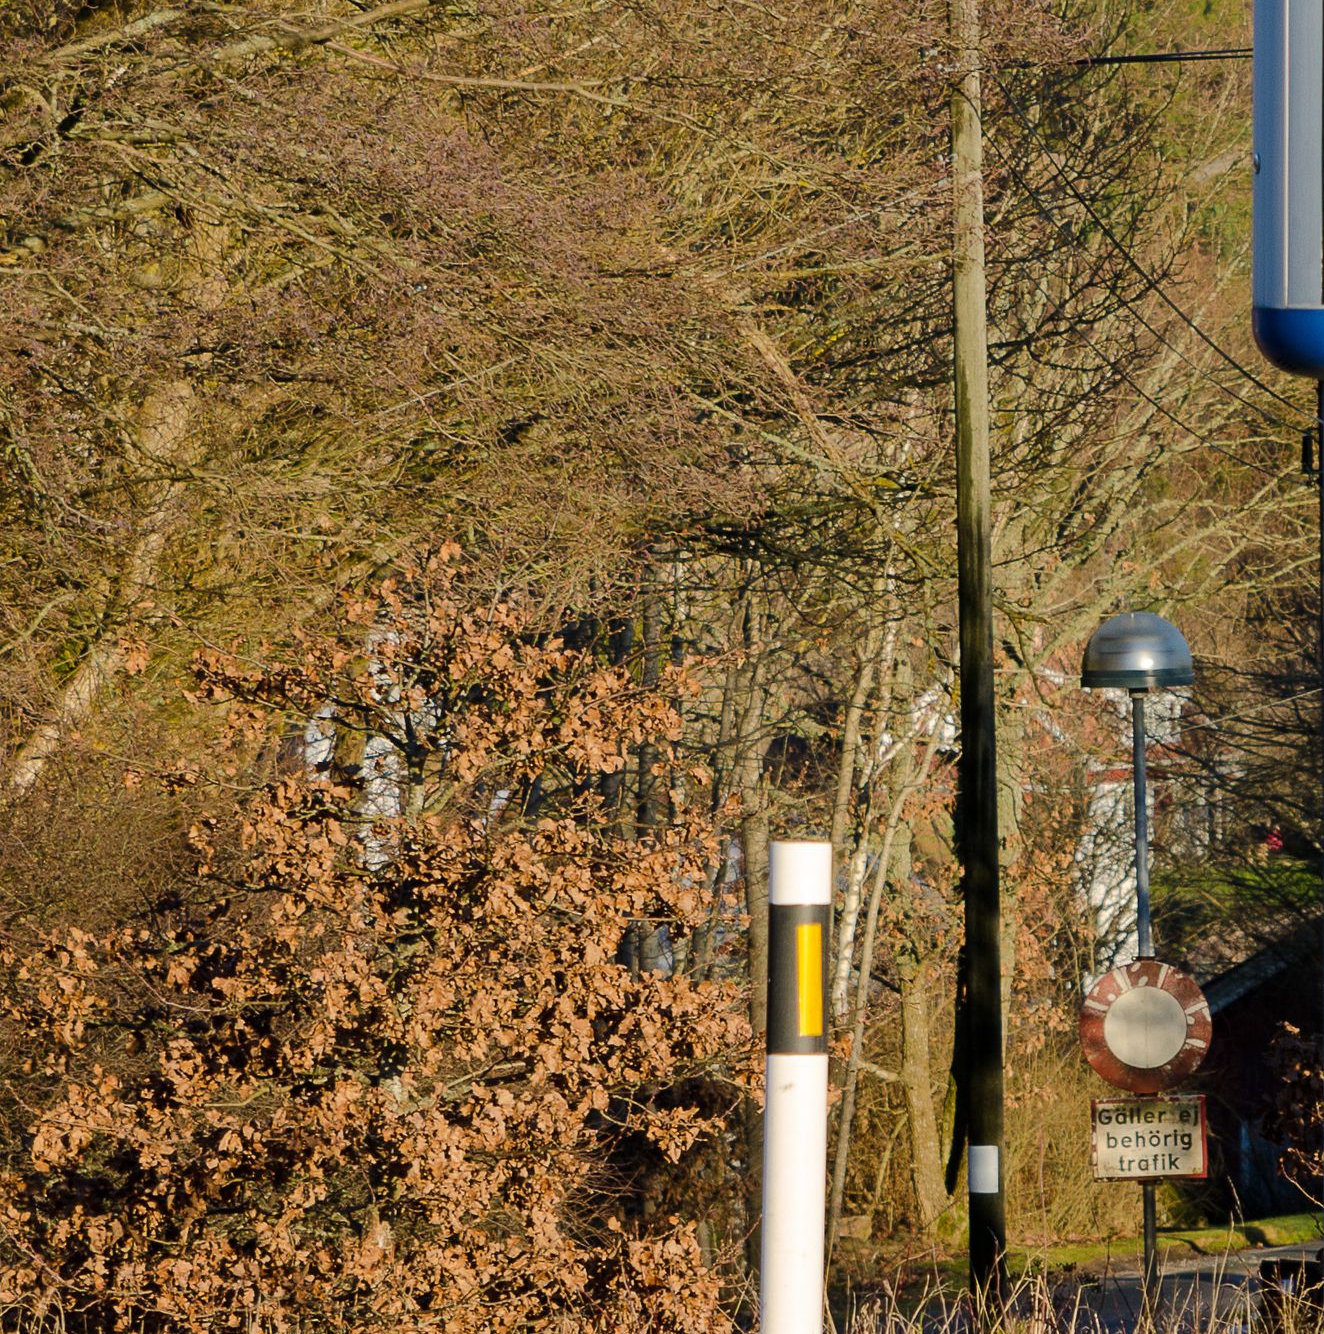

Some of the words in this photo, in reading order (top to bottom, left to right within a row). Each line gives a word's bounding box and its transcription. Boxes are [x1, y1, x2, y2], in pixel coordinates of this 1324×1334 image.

[1098, 1107, 1167, 1126] Gäller
[1179, 1106, 1199, 1126] ej
[1106, 1129, 1193, 1151] behörig
[1119, 1153, 1180, 1172] trafik
